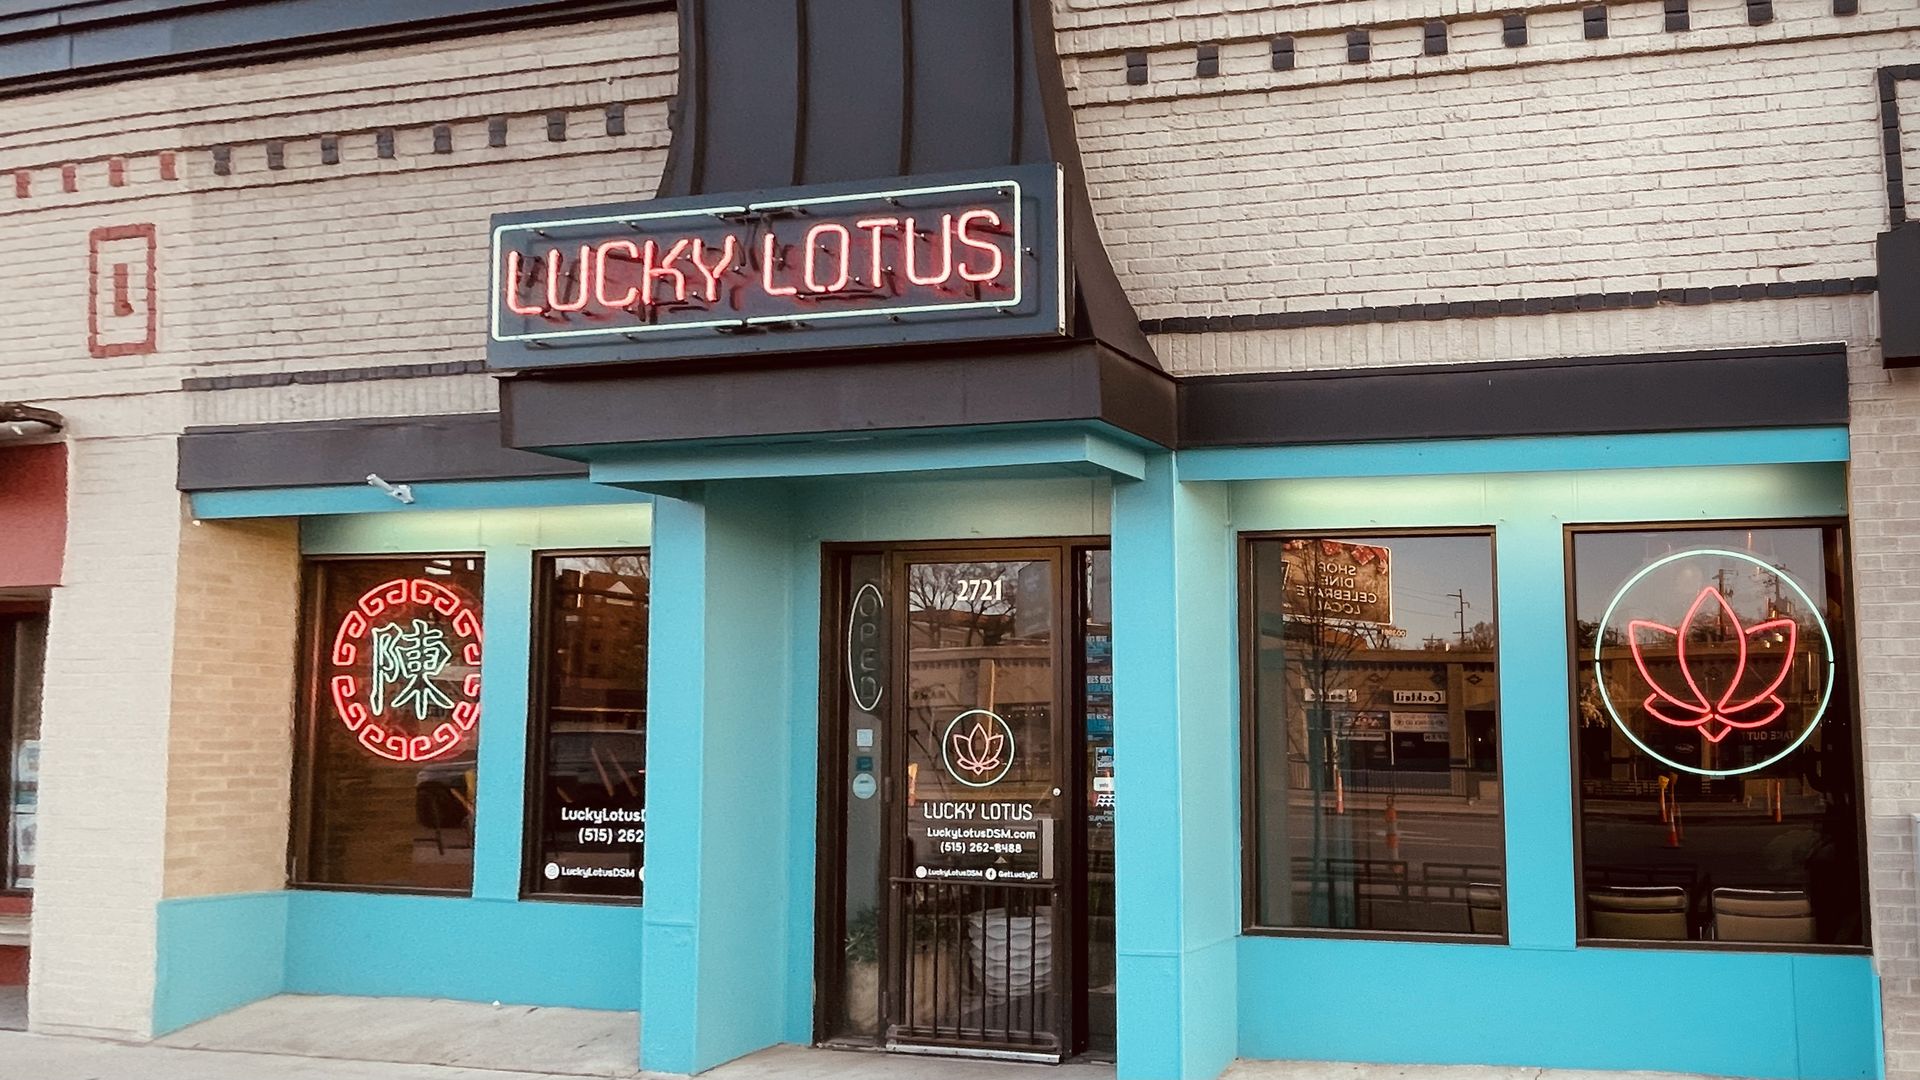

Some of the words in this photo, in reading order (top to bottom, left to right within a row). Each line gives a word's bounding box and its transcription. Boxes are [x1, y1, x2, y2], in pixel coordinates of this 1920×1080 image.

[507, 234, 736, 315] LUCKY
[763, 209, 1003, 296] LOTUS
[957, 579, 1003, 601] 2721
[923, 802, 976, 820] LUCKY
[981, 803, 1033, 821] LOTUS
[578, 827, 613, 845] (515)
[617, 828, 645, 843] 262
[926, 827, 1036, 840] LuckyLotusDSM.com
[940, 841, 967, 854] (515)
[969, 842, 1023, 853] 262-8488
[561, 866, 636, 878] LuckyLotusDSM
[928, 868, 983, 878] LuckyLotusDSM
